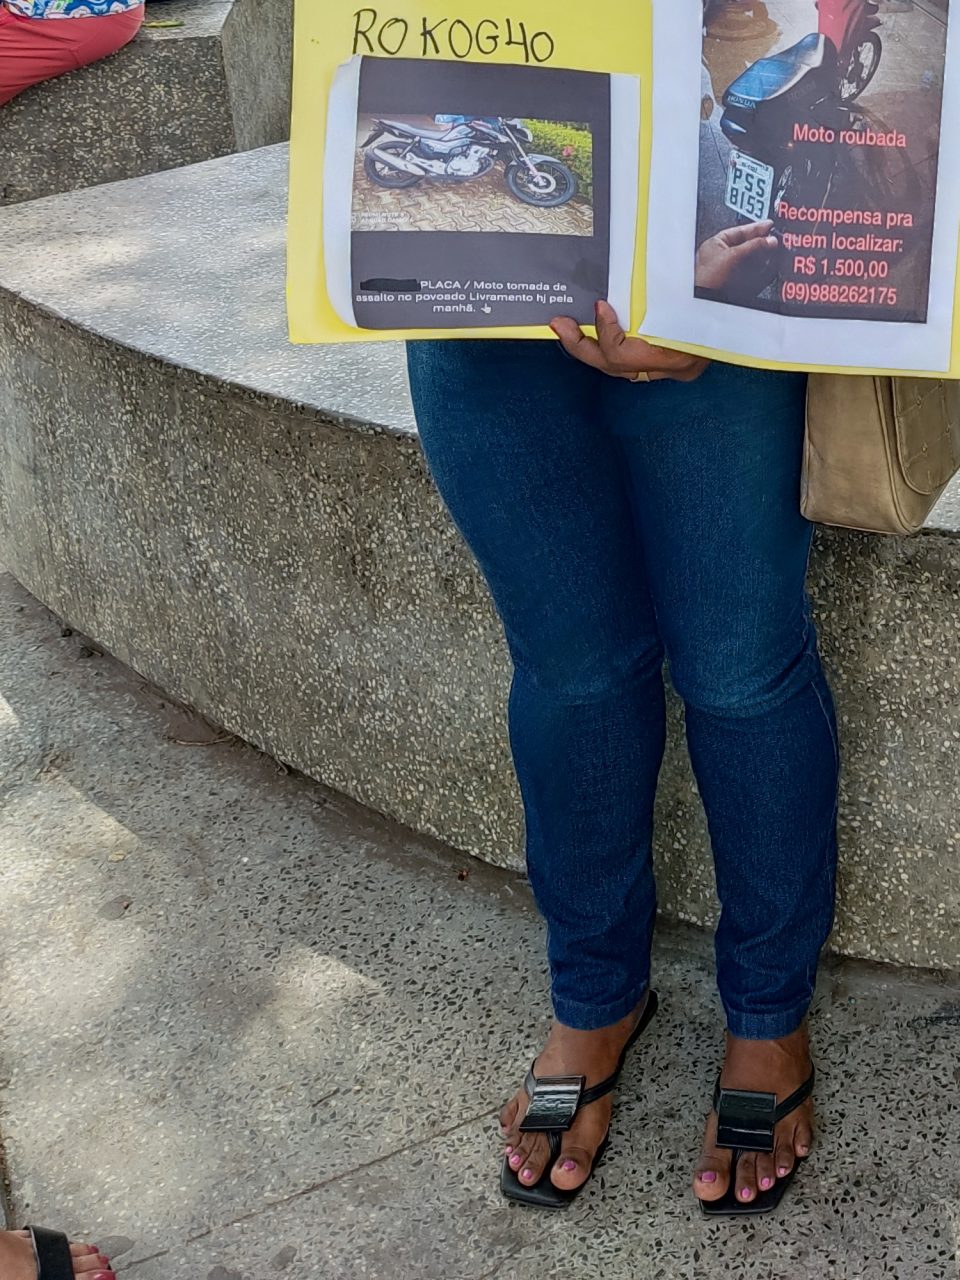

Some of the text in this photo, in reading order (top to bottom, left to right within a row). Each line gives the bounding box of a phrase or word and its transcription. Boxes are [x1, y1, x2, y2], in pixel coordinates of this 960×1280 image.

[793, 122, 907, 147] Moto roubada
[732, 167, 766, 198] PSS
[729, 187, 765, 220] 8153
[778, 201, 913, 230] Recompensa pra
[782, 231, 904, 253] quem localizar:
[793, 255, 888, 280] R$ 1.500,00
[355, 292, 573, 304] assalto no povoado Livramento hj pela
[420, 280, 461, 289] PLACA
[473, 281, 504, 290] Moto
[506, 282, 550, 291] tomada
[552, 282, 567, 292] de
[781, 281, 898, 305] (99)988262175
[432, 303, 476, 313] manhã.
